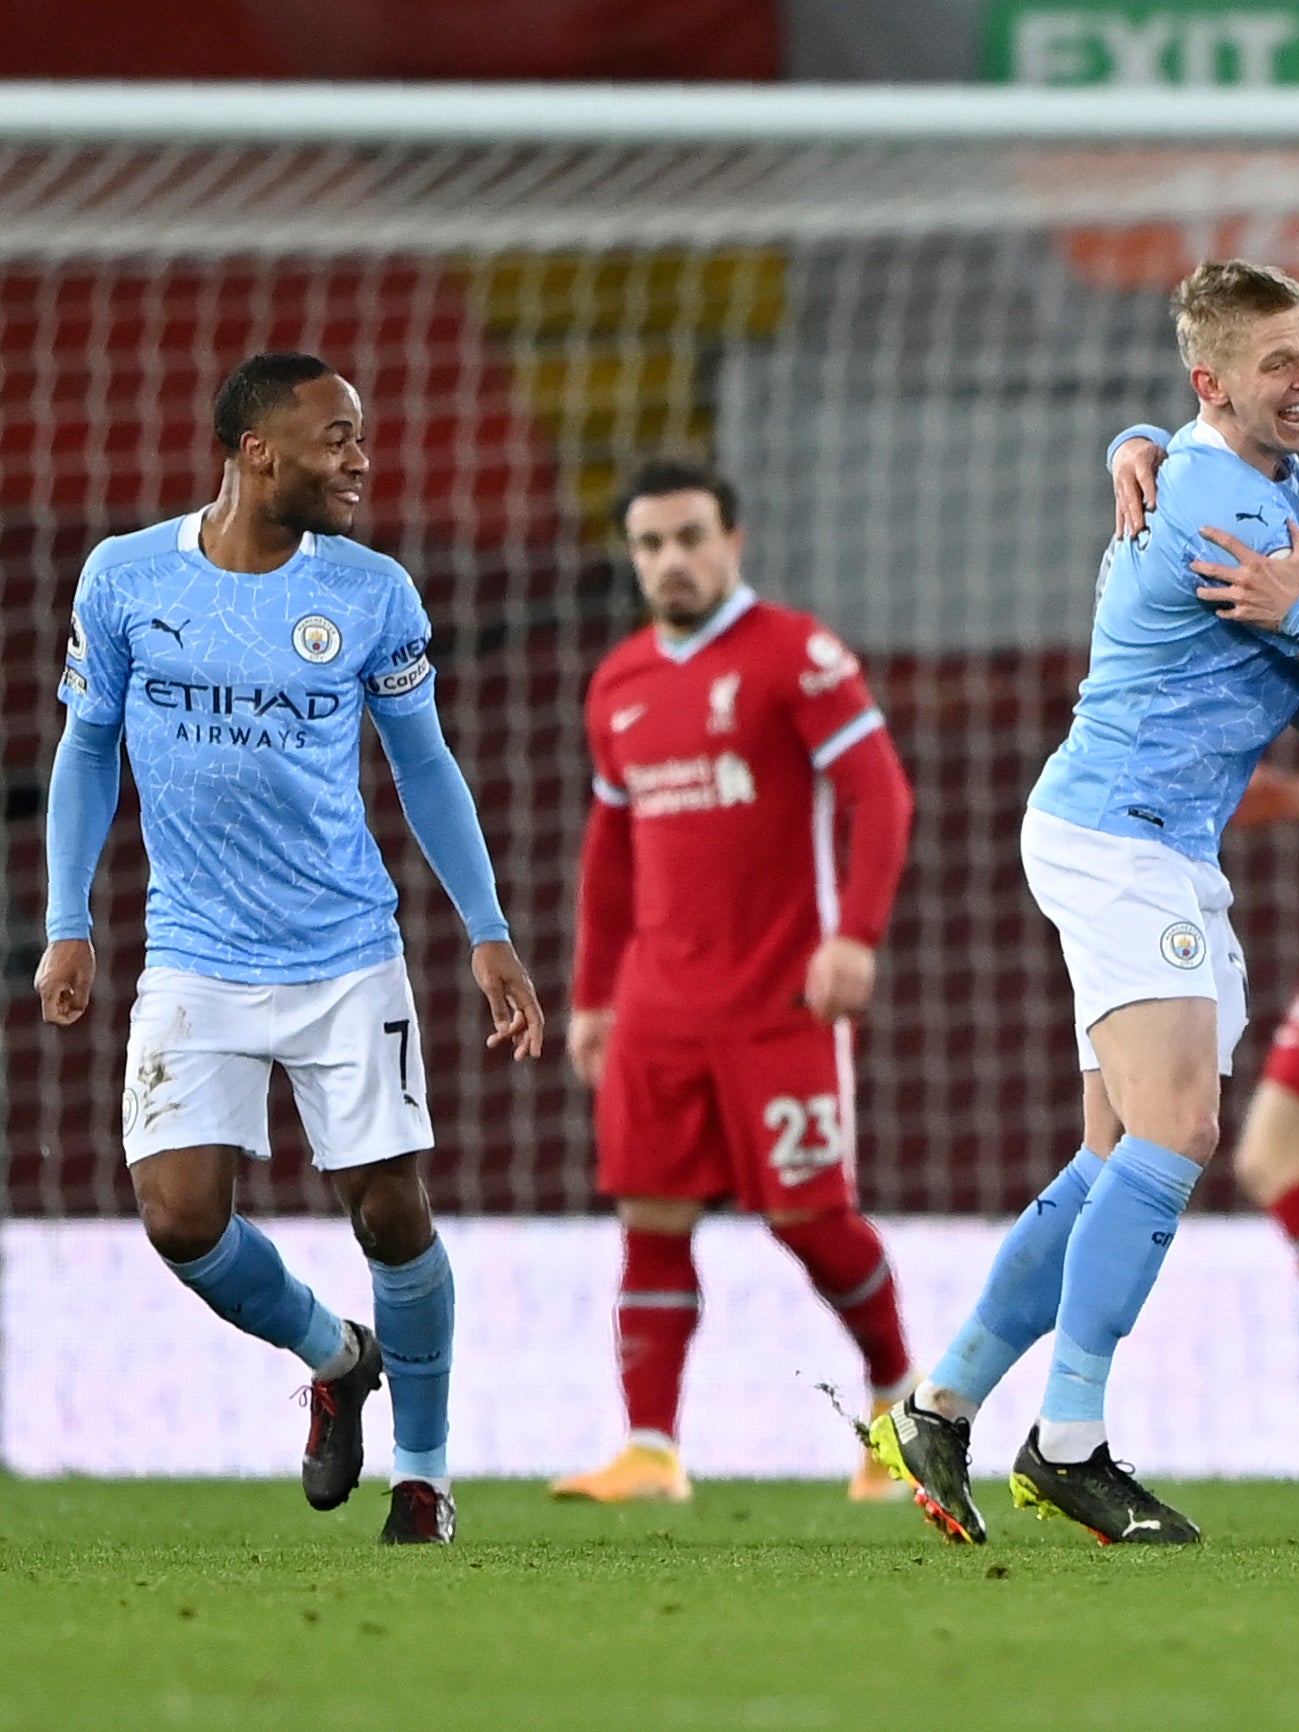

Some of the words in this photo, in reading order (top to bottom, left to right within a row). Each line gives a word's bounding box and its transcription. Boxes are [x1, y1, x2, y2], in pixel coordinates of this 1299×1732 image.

[1012, 14, 1290, 94] EXIT
[145, 678, 340, 721] ETIHAD
[175, 721, 307, 750] AIRWAYS
[384, 1019, 410, 1090] 7
[764, 1094, 844, 1168] 23
